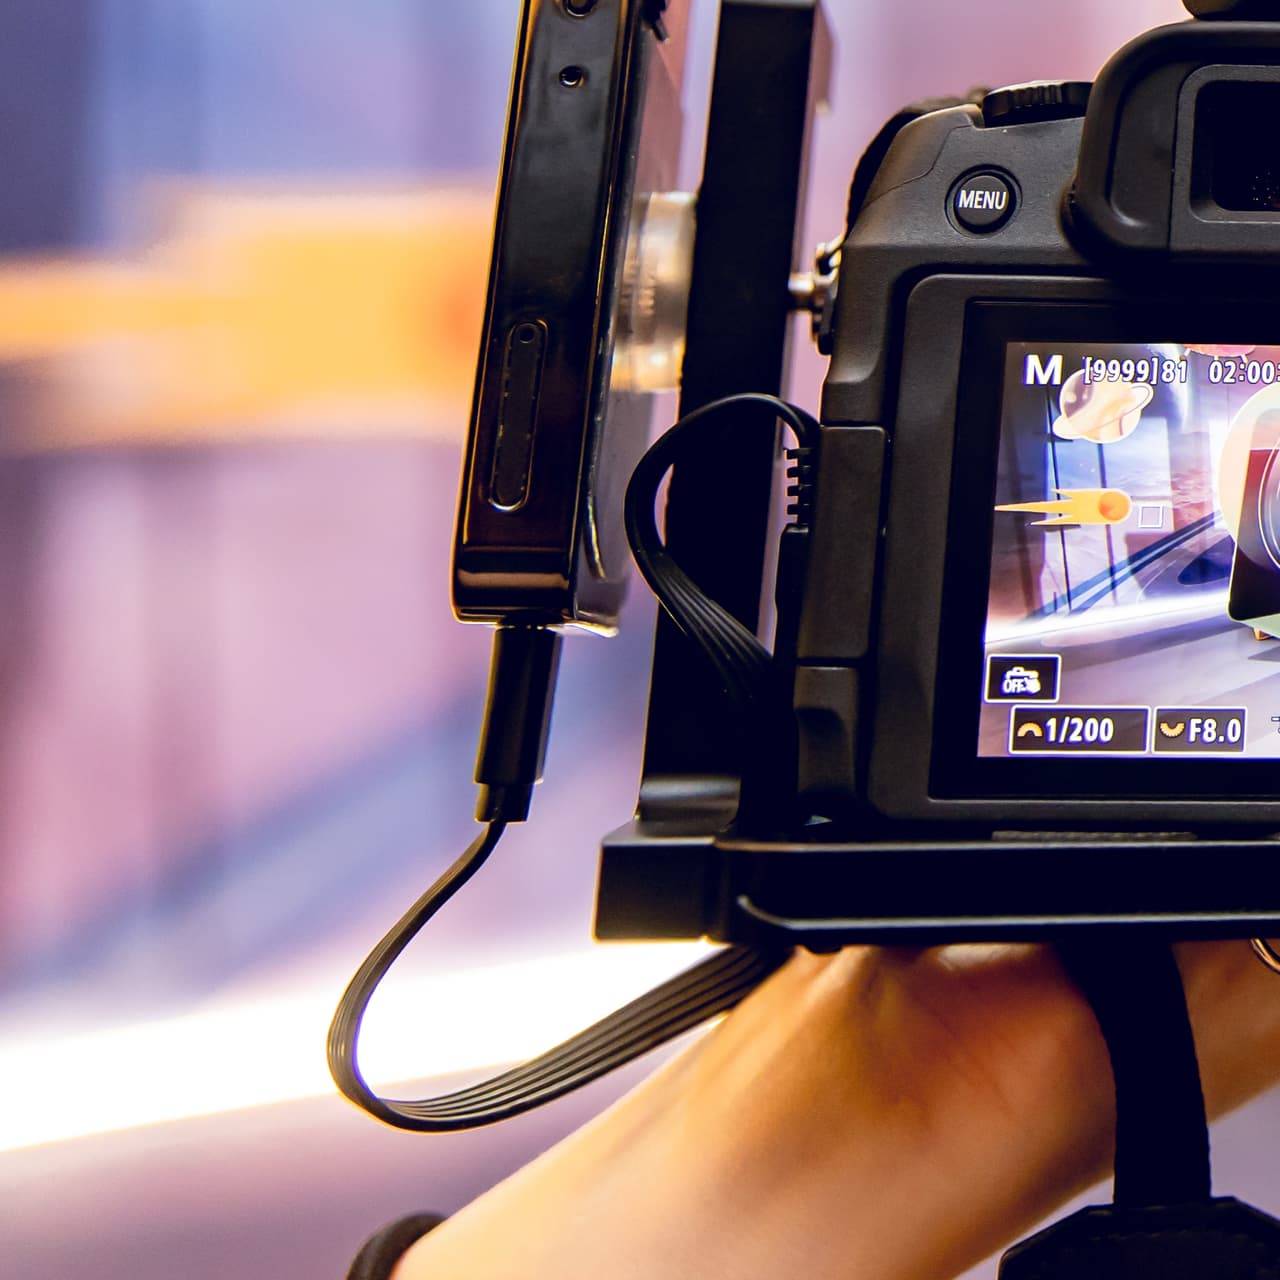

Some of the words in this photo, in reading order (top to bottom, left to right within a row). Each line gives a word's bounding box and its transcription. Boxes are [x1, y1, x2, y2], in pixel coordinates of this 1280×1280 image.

[958, 189, 1007, 209] MENU
[1023, 354, 1063, 385] M
[1044, 716, 1114, 744] 1/200
[1188, 718, 1242, 743] F8.0
